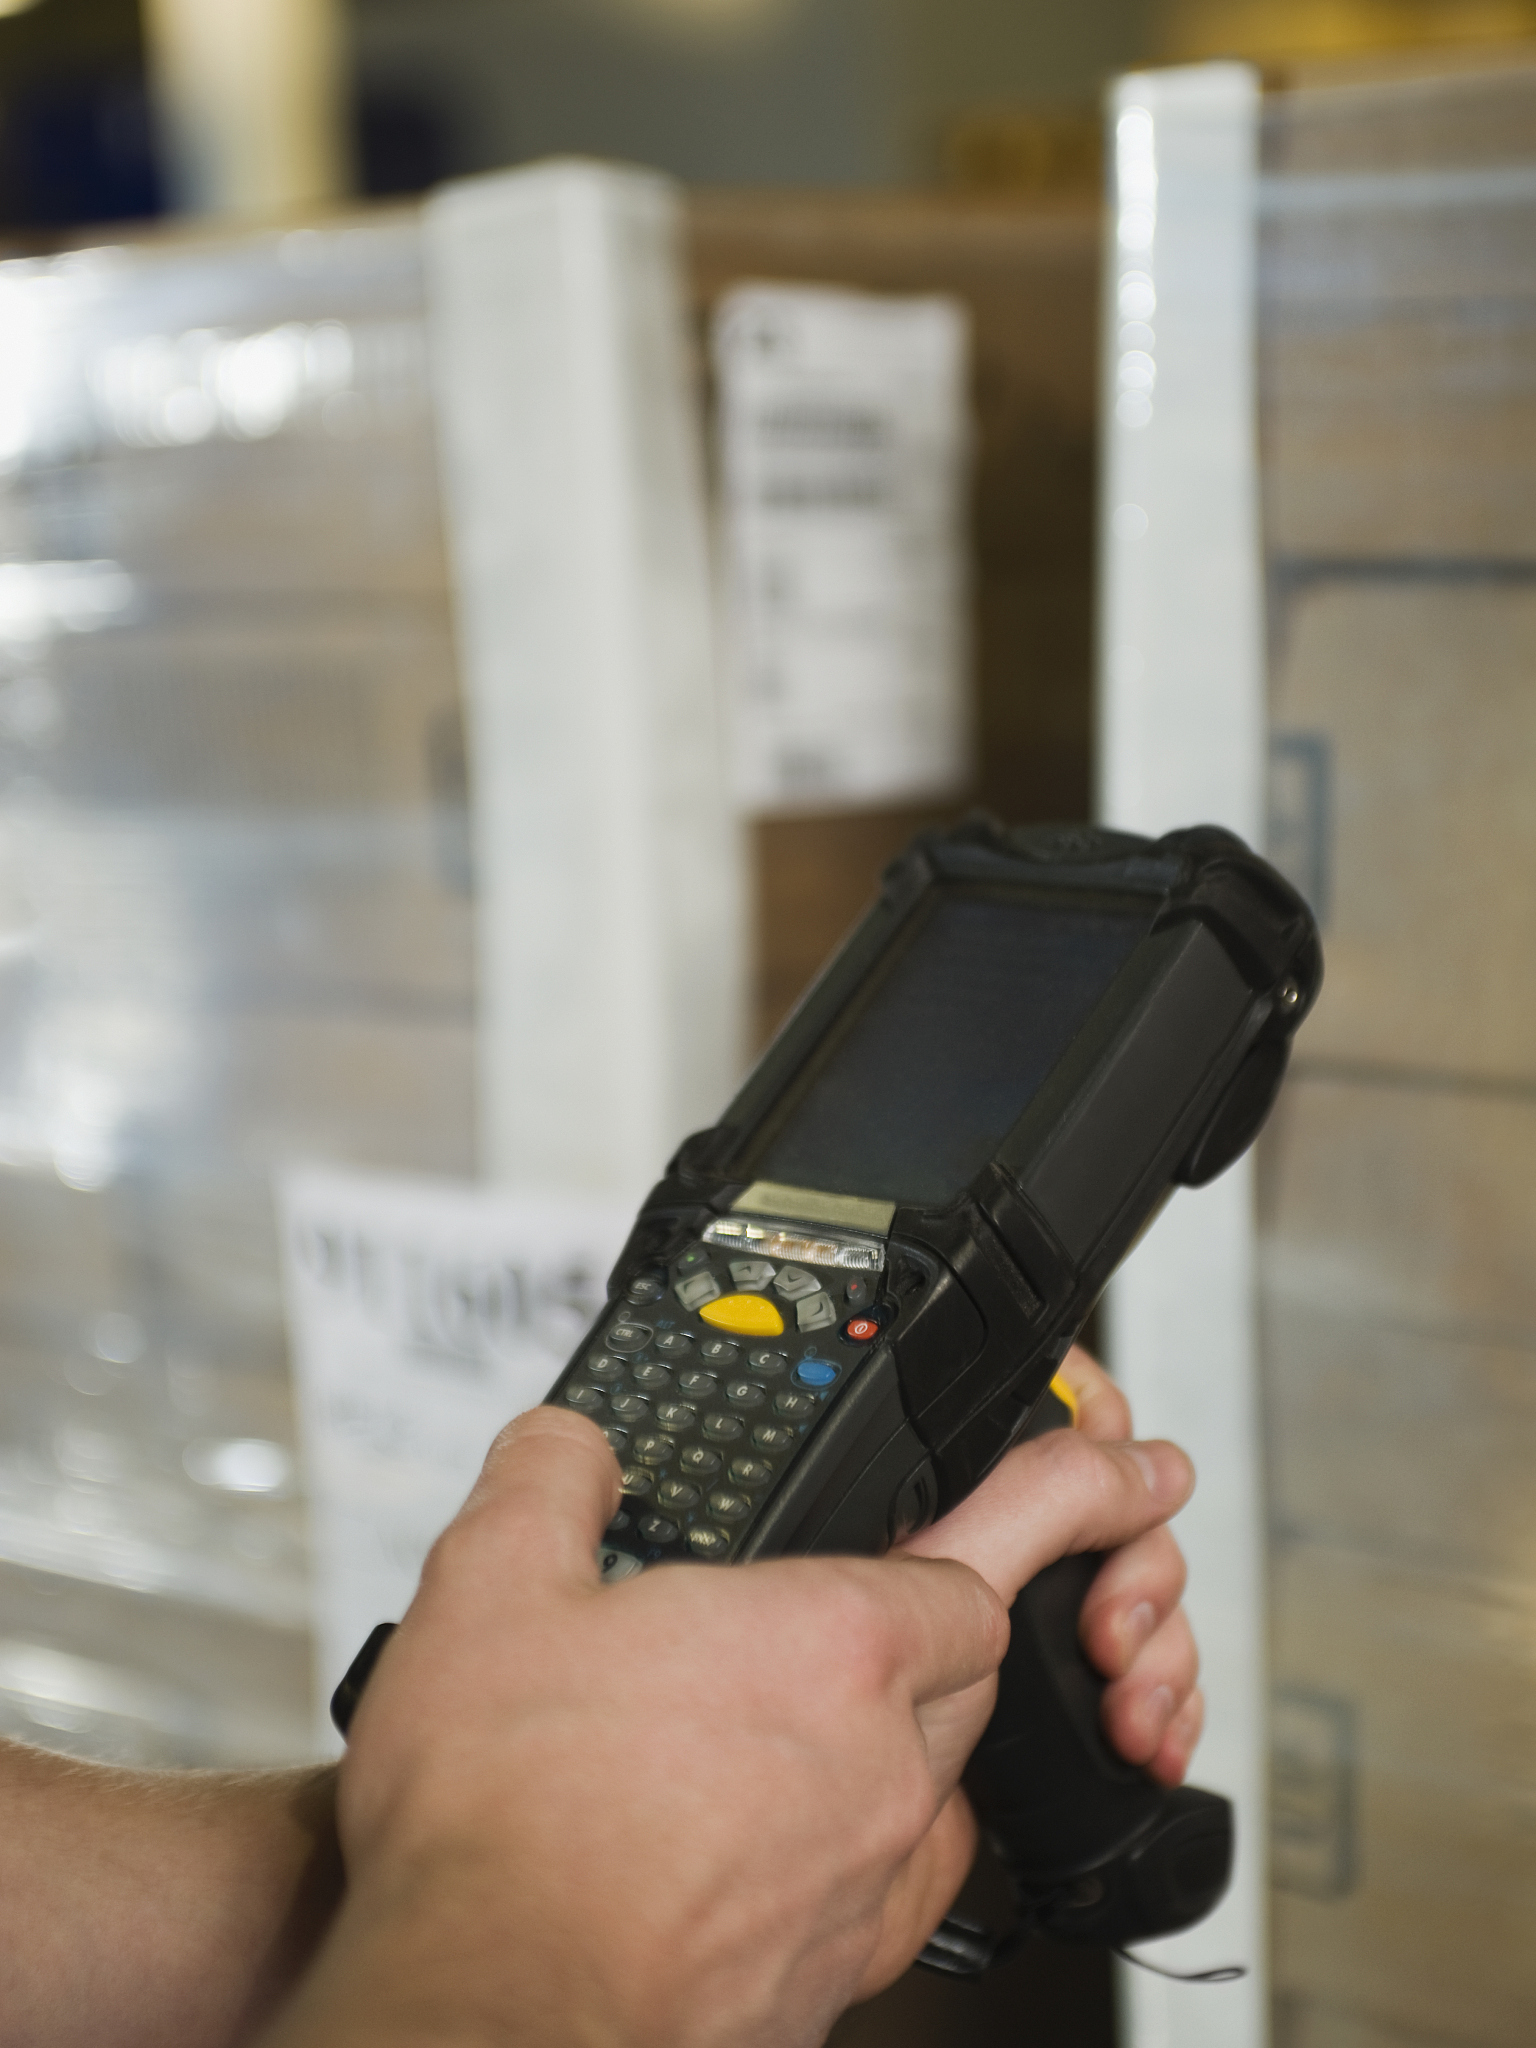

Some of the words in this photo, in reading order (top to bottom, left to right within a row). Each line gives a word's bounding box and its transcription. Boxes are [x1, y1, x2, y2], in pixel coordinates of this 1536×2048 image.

[635, 1282, 651, 1291] ESC
[615, 1328, 633, 1338] CTRL
[664, 1335, 674, 1346] A
[711, 1344, 722, 1354] B
[597, 1359, 608, 1369] D
[759, 1354, 770, 1365] C
[643, 1366, 653, 1377] E
[688, 1375, 700, 1386] F
[736, 1385, 748, 1397] G
[620, 1398, 630, 1409] J
[785, 1397, 798, 1409] H
[665, 1407, 678, 1419] K
[714, 1418, 724, 1429] L
[762, 1429, 777, 1443] M
[644, 1440, 656, 1451] P
[692, 1447, 704, 1464] Q
[742, 1464, 754, 1477] R
[670, 1485, 683, 1498] V
[718, 1498, 735, 1512] W
[648, 1519, 661, 1532] Z
